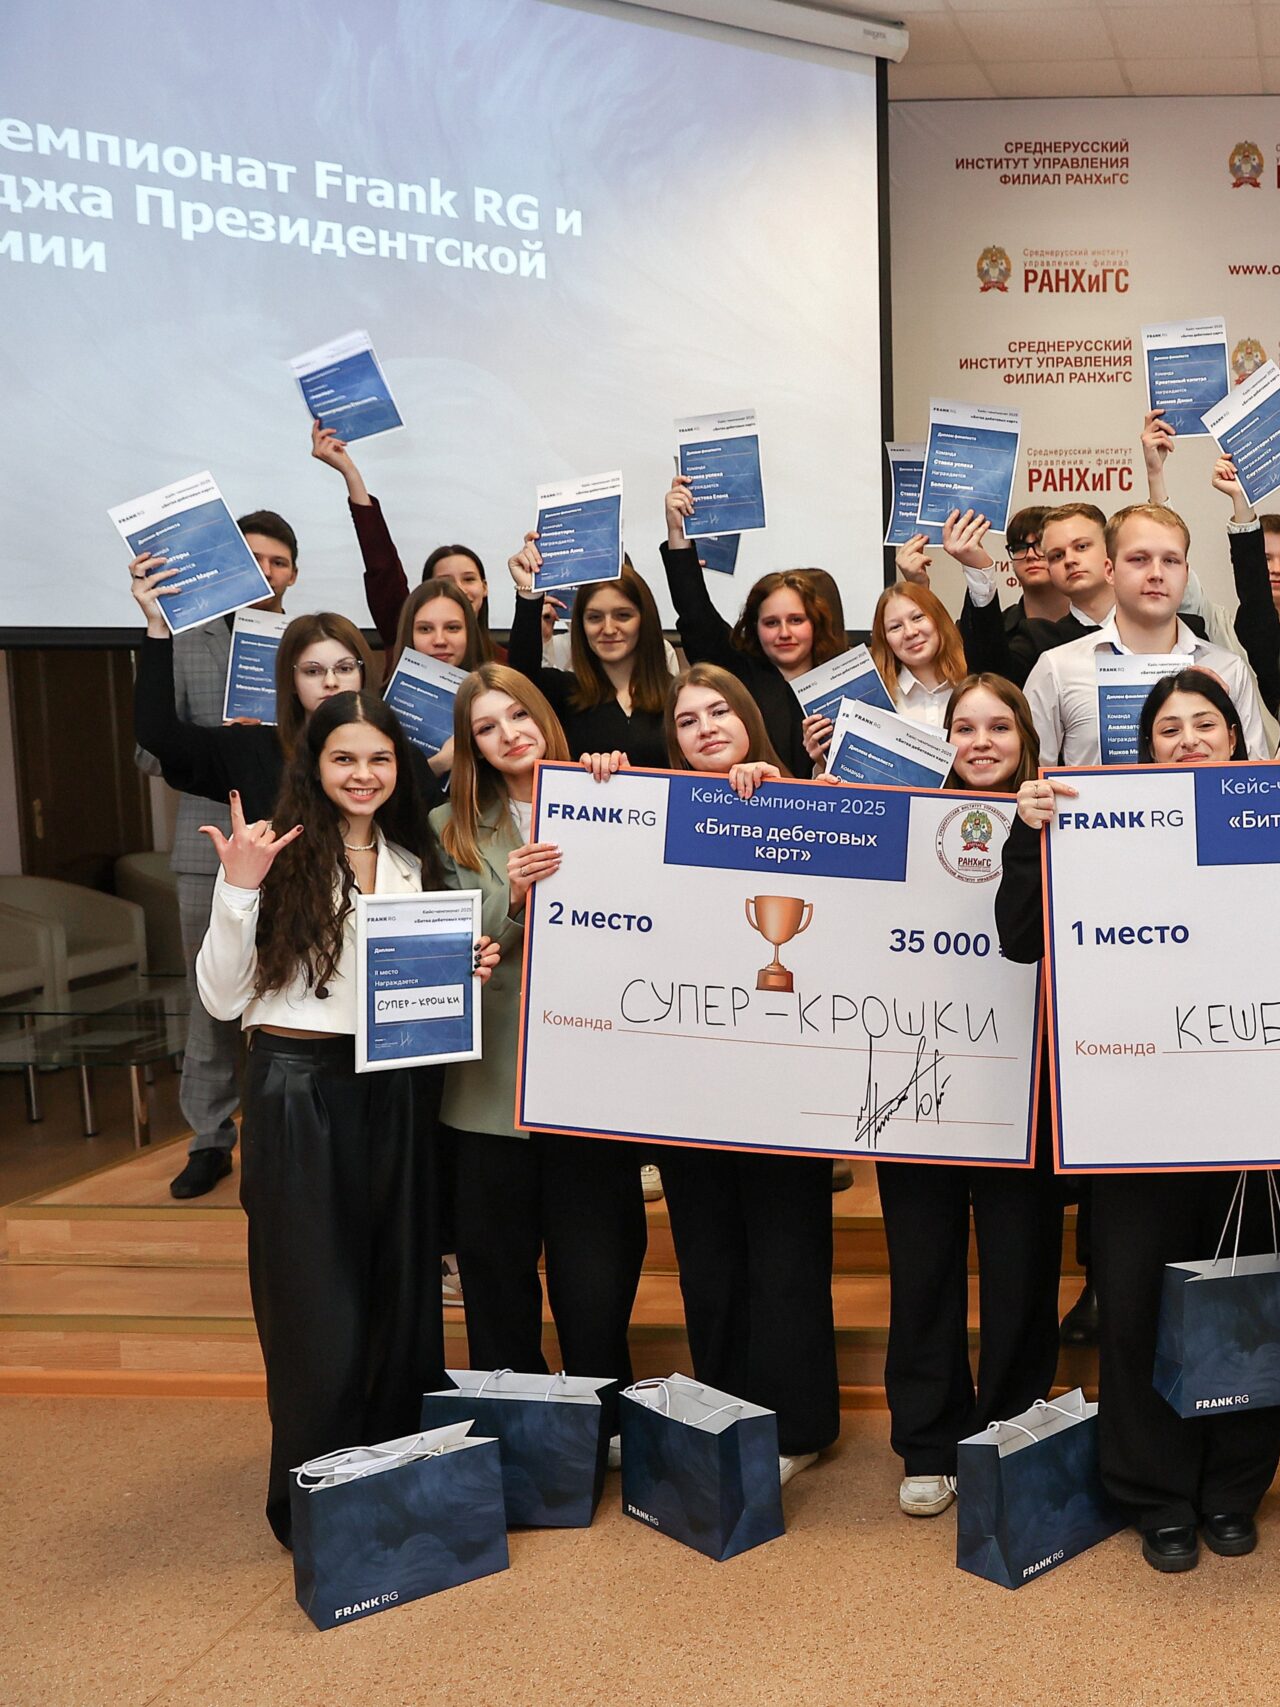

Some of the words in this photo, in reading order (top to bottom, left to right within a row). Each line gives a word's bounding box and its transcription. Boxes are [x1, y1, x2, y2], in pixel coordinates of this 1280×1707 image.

[1004, 139, 1129, 154] СРЕДНЕРУССКИЙ
[955, 157, 1030, 170] ИНСТИТУТ
[1033, 157, 1129, 170] УПРАВЛЕНИЯ
[1000, 173, 1062, 185] ФИЛИАЛ
[1066, 173, 1129, 185] РАНХиГС
[314, 160, 459, 219] Frank
[473, 187, 540, 232] RG
[555, 206, 583, 237] и
[135, 184, 547, 280] Президентской
[1023, 248, 1089, 257] Среднерусский
[1092, 248, 1129, 257] институт
[1024, 269, 1129, 293] РАНХиГС
[1008, 336, 1132, 352] СРЕДНЕРУССКИЙ
[959, 356, 1034, 369] ИНСТИТУТ
[1037, 356, 1132, 369] УПРАВЛЕНИЯ
[1003, 371, 1062, 383] ФИЛИАЛ
[1069, 371, 1132, 383] РАНХиГС
[1028, 467, 1132, 492] РАНХиГС
[547, 803, 623, 824] FRANK
[627, 808, 656, 827] RG
[840, 798, 886, 816] 2025
[1058, 811, 1145, 830] FRANK
[1150, 810, 1184, 827] RG
[694, 818, 762, 839] «Битва
[766, 825, 877, 847] дебетовых
[755, 846, 811, 863] карт»
[958, 857, 991, 867] РАНХиГС
[548, 901, 563, 925] 2
[570, 908, 652, 933] место
[888, 928, 924, 953] 35
[934, 931, 990, 956] 000
[1071, 920, 1085, 945] 1
[1095, 924, 1189, 945] место
[374, 979, 418, 987] Награждается
[542, 1010, 612, 1031] Команда
[1074, 1040, 1156, 1058] Команда
[1195, 1396, 1233, 1410] FRANK
[1234, 1394, 1249, 1404] RG
[628, 1503, 650, 1522] FRANK
[650, 1514, 660, 1527] RG
[1022, 1556, 1052, 1578] FRANK
[1052, 1549, 1064, 1562] RG
[334, 1598, 380, 1620] FRANK
[381, 1591, 399, 1603] RG
